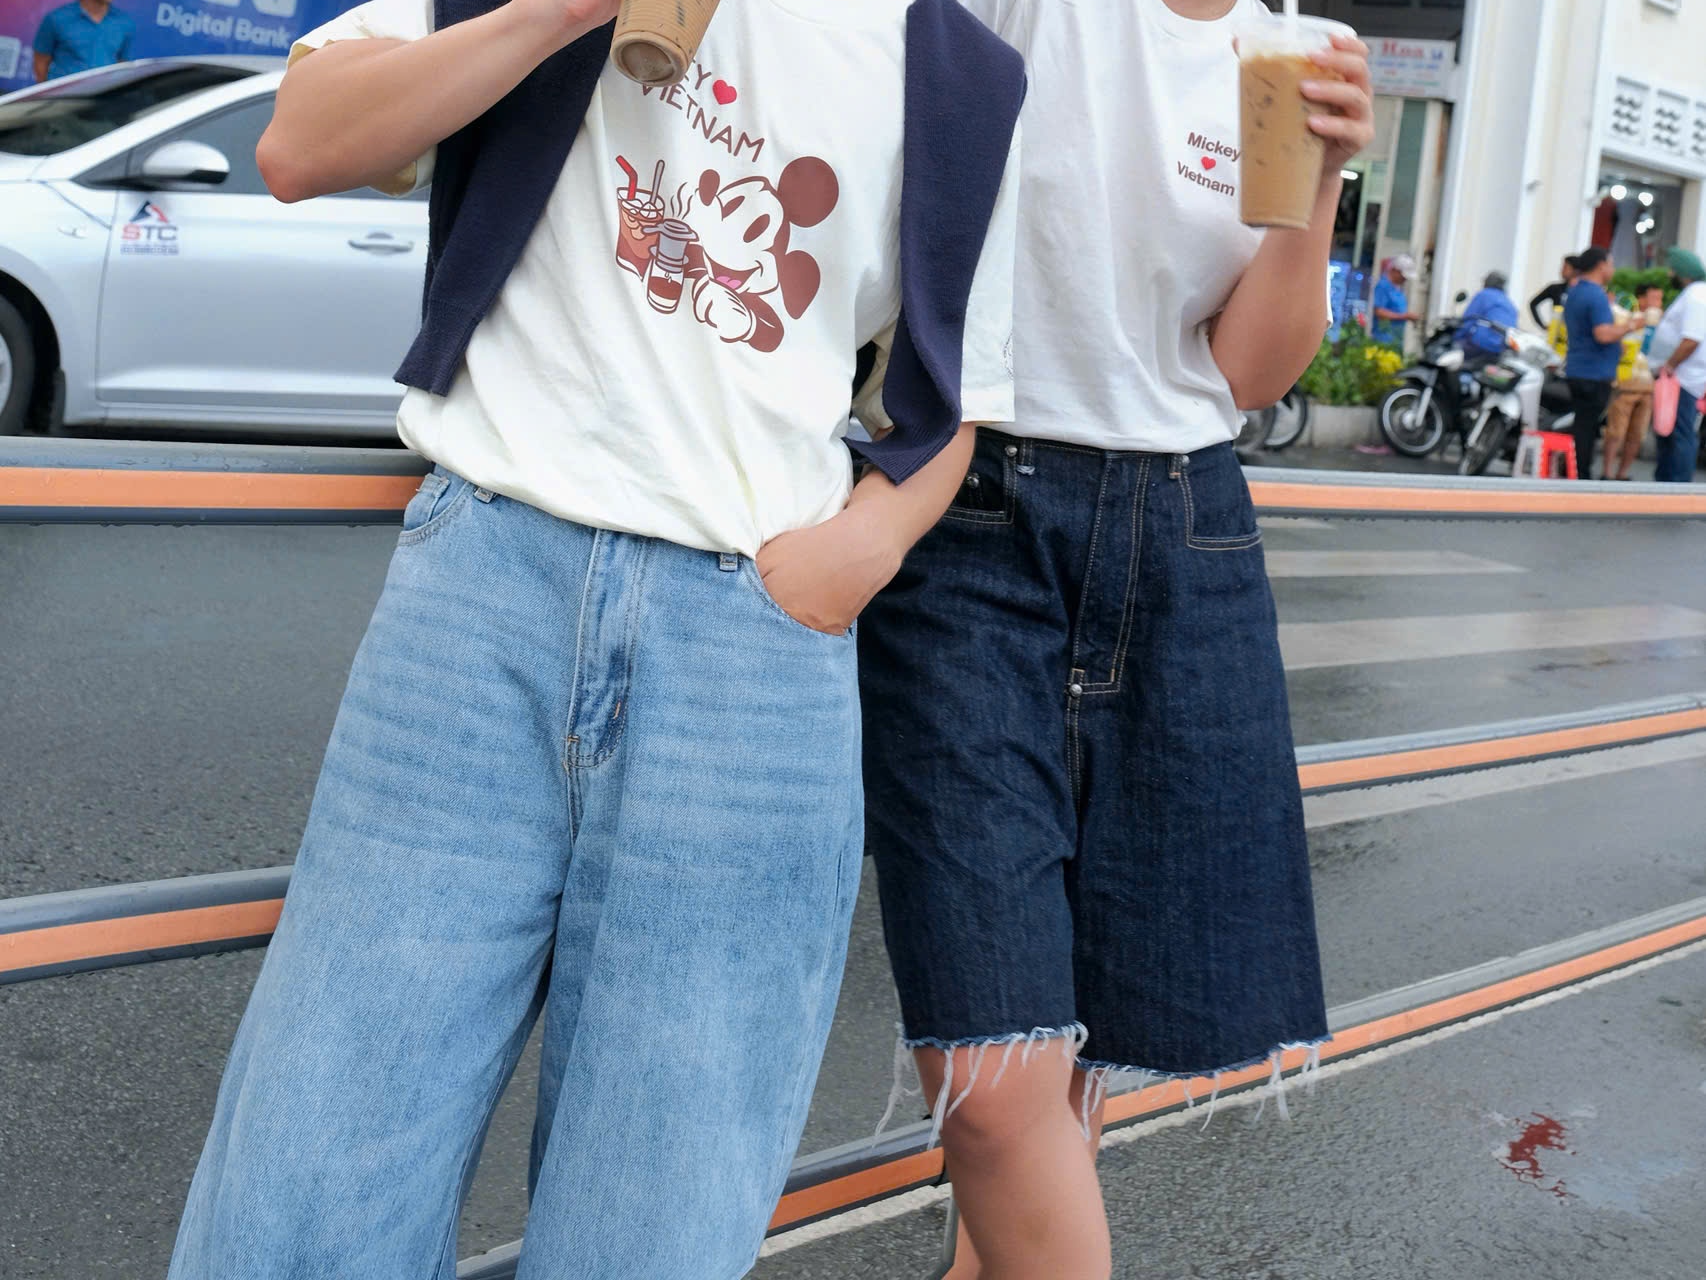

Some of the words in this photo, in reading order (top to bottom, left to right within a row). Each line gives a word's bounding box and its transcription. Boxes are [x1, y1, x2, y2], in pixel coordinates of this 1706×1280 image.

[156, 3, 233, 37] Digital
[234, 18, 292, 49] Bank
[1187, 132, 1241, 162] Mickey
[1177, 161, 1235, 197] Vietnam
[122, 224, 178, 240] STC
